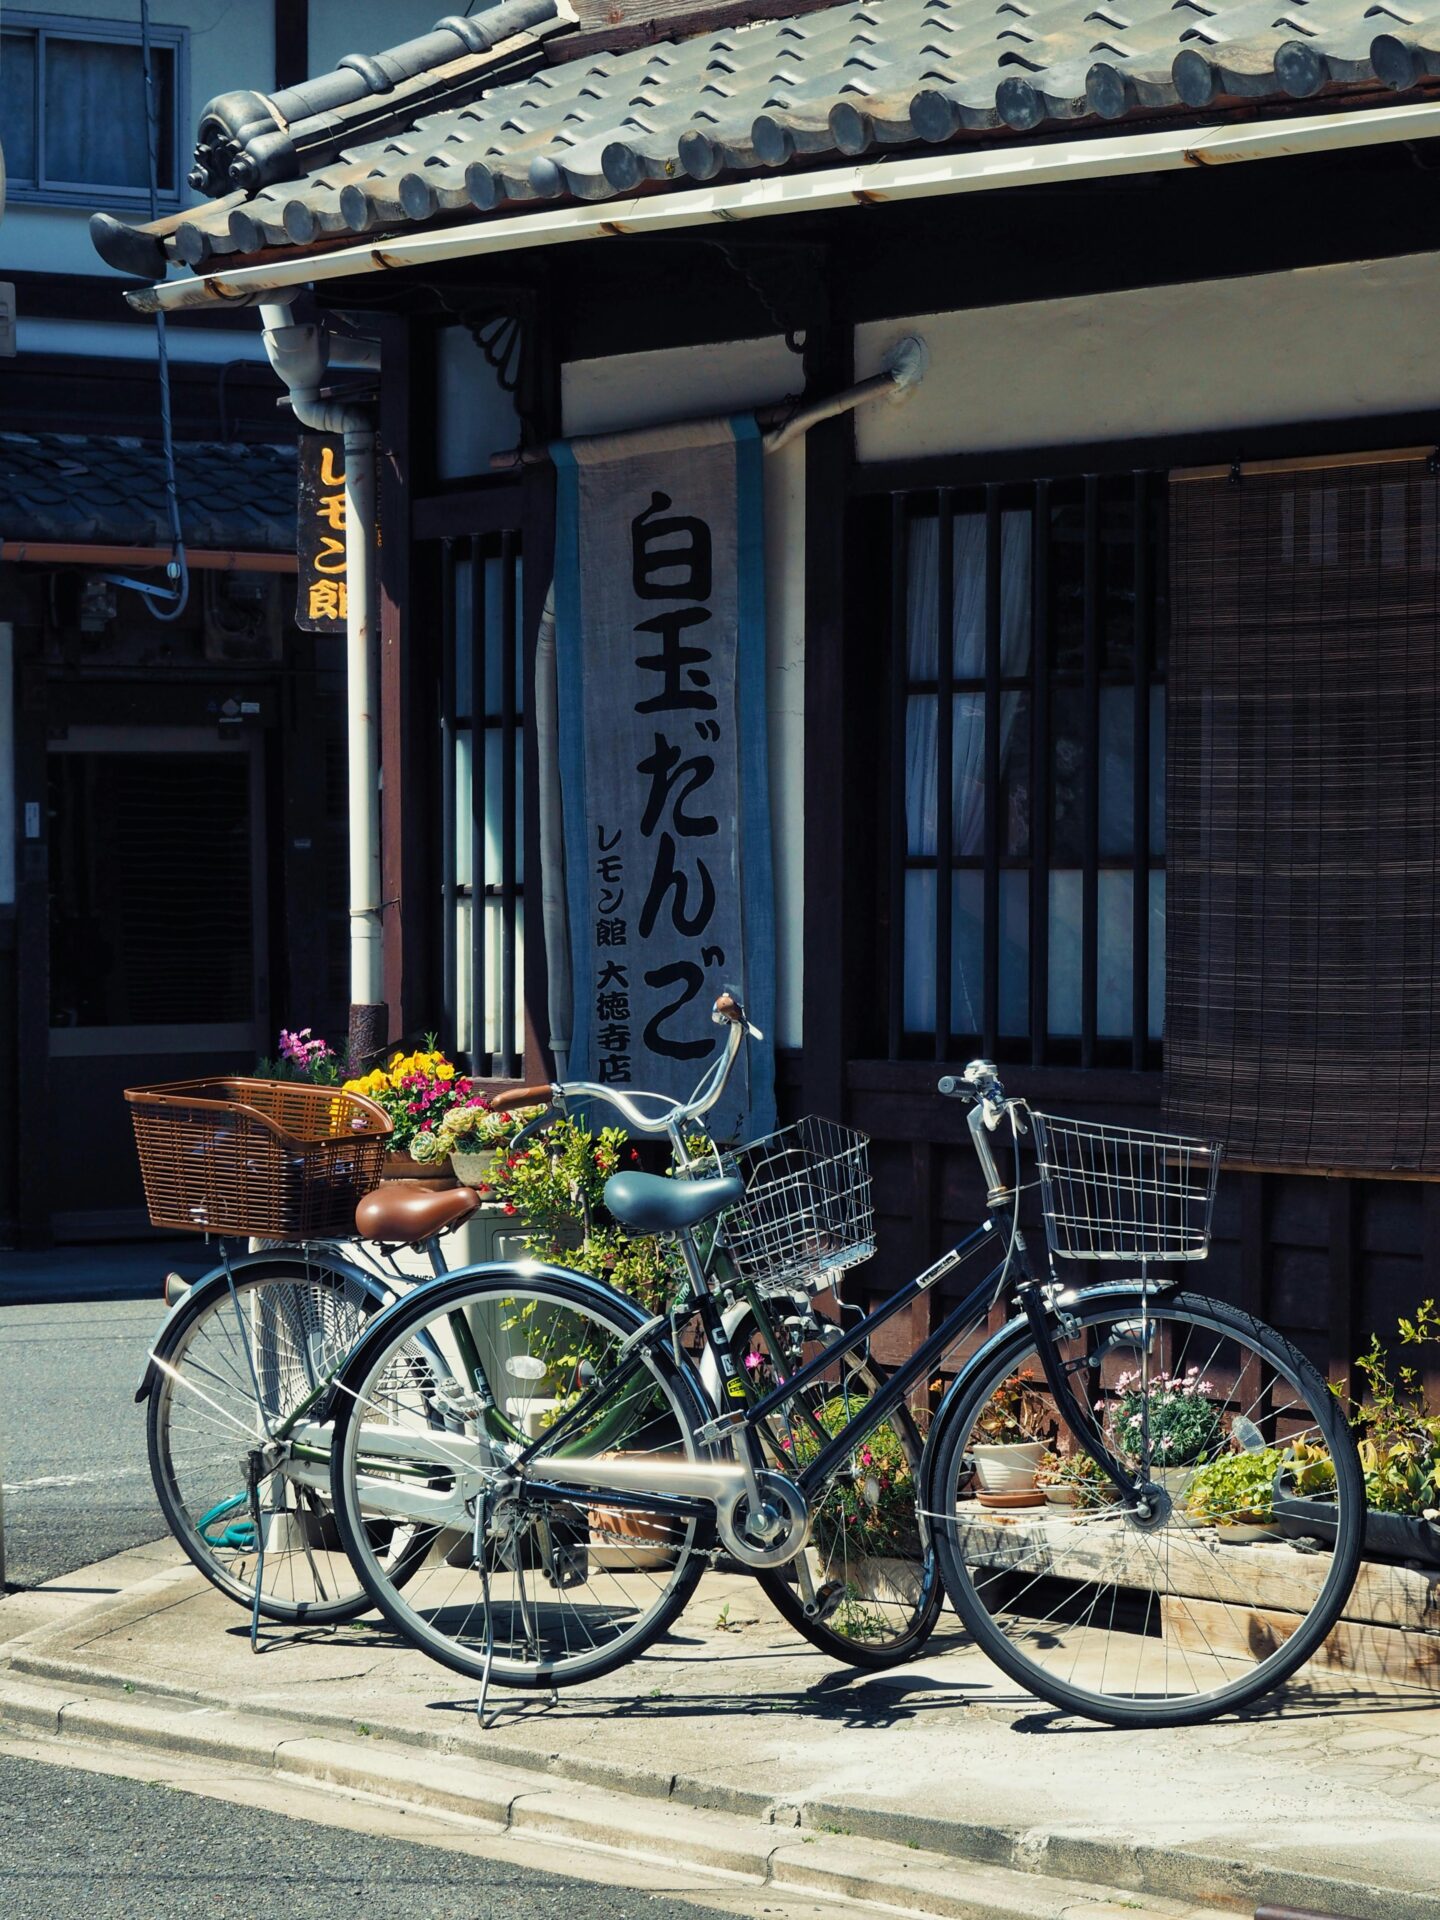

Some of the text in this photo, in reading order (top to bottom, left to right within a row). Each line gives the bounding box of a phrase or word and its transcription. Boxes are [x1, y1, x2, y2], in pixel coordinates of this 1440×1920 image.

[595, 824, 633, 1084] レモン館 大徳寺店
[632, 490, 725, 1061] 白玉だんご
